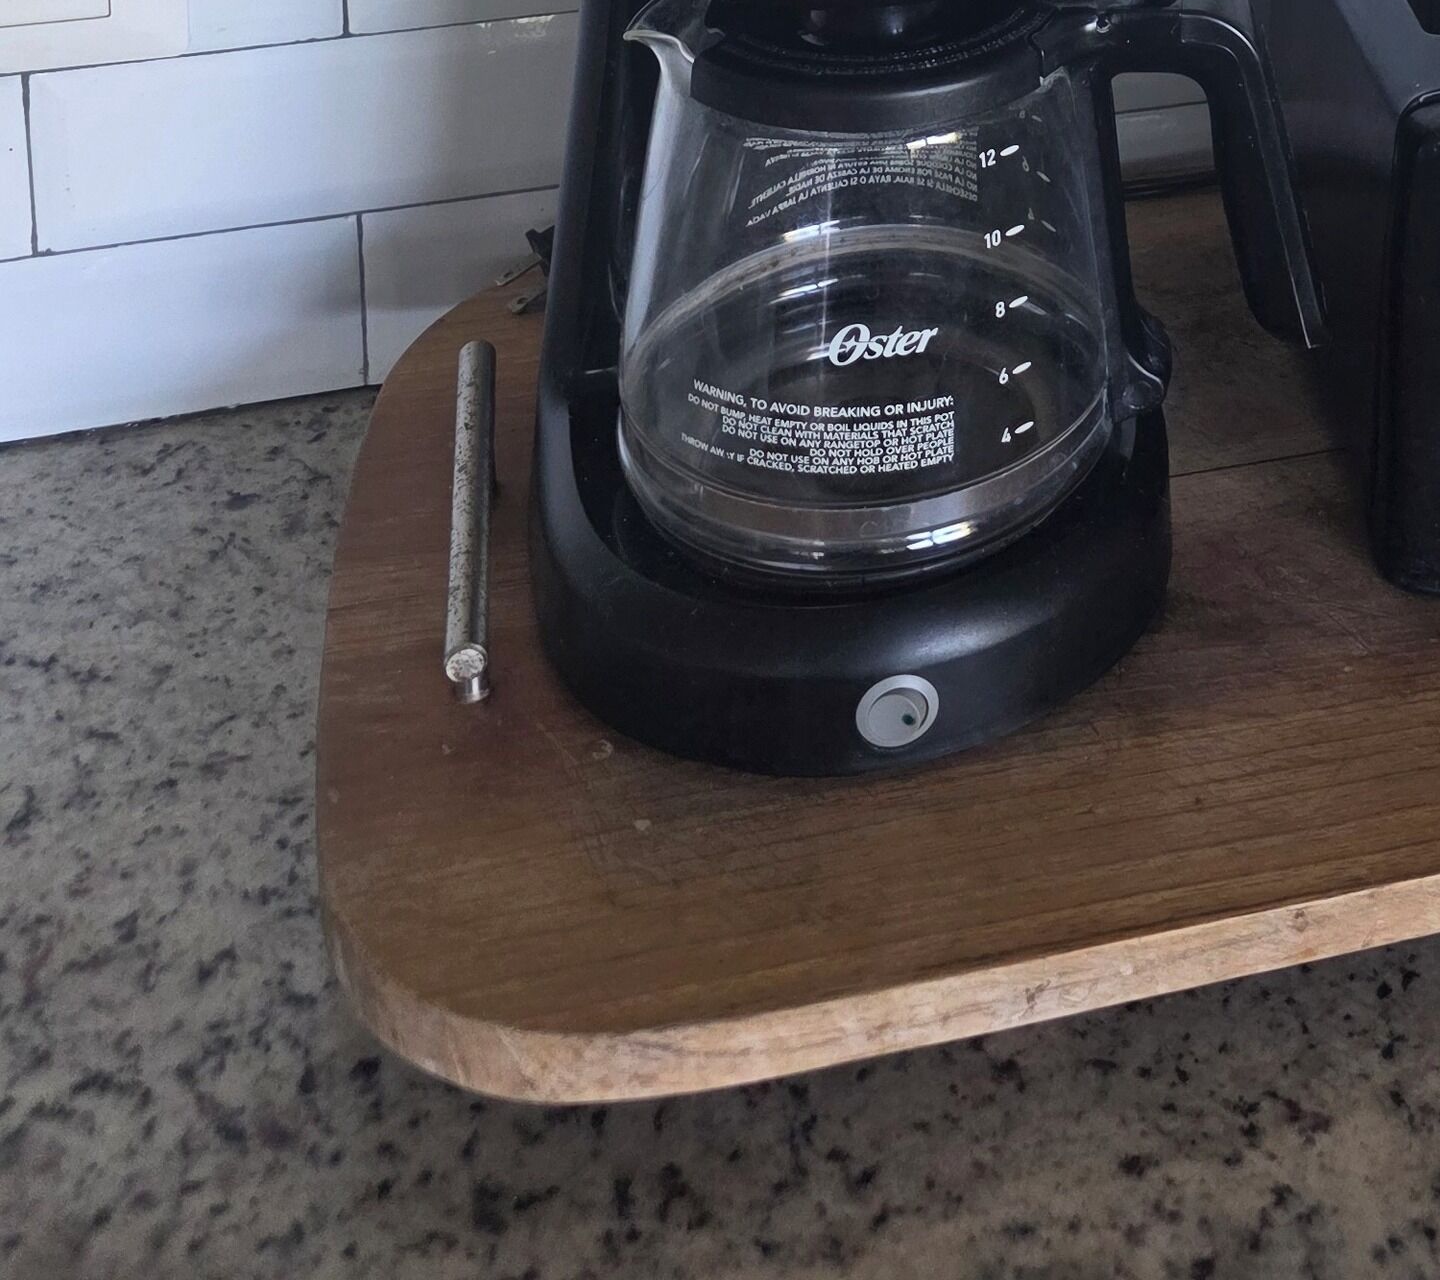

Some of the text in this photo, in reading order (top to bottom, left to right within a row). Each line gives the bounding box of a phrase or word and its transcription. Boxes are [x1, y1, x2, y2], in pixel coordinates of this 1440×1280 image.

[979, 149, 996, 168] 12
[984, 229, 1001, 249] 10
[995, 301, 1005, 318] 8
[828, 323, 939, 366] Oster
[999, 367, 1008, 384] 6
[694, 379, 954, 417] WARNING, TO AVOID BREAKING OR INJURY:
[688, 393, 955, 432] DO NOT BUMP, HEAT EMPTY OR BOIL LIQUIDS IN THIS POT
[722, 416, 954, 440] DO NOT CLEAN WITH MATERIALS THAT SCRATCH
[722, 425, 954, 449] DO NOT USE ON ANY RANGETOP OR HOT PLATE
[1001, 427, 1011, 443] 4
[749, 445, 954, 466] DO NOT USE ON ANY HOB OR HOT PLATE
[810, 437, 954, 457] DO NOT HOLD OVER PEOPLE
[747, 457, 795, 472] CRACKED,
[797, 464, 858, 474] SCRATCHED
[860, 465, 876, 474] OR
[878, 460, 918, 472] HEATED
[921, 454, 954, 467] EMPTY
